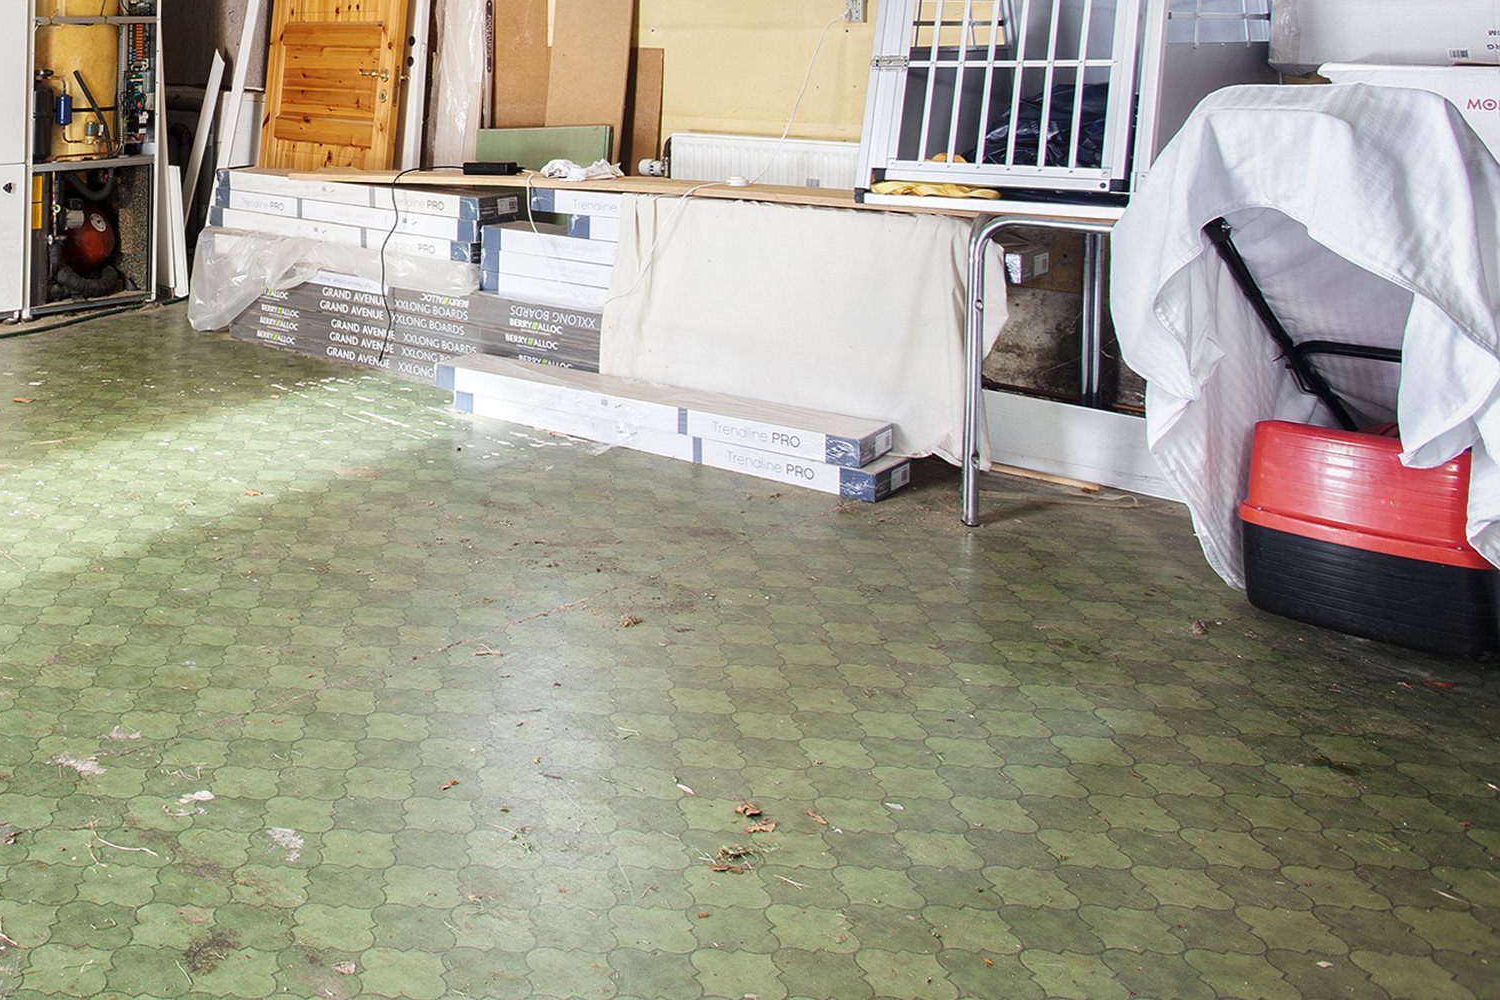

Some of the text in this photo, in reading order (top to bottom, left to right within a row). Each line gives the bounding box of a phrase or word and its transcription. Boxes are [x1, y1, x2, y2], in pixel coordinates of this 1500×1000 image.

[1467, 99, 1500, 110] MO
[269, 201, 285, 212] PRO
[426, 199, 445, 211] PRO
[574, 199, 618, 212] Trendline
[417, 242, 436, 255] PRO
[322, 287, 352, 301] GRAND
[261, 304, 299, 317] BERRY ALLOC
[320, 300, 384, 320] GRAND AVENUE
[395, 300, 469, 321] XXLONG BOARDS
[510, 305, 597, 329] XXLONG BOARDS
[260, 316, 298, 330] BERRY ALLOC
[331, 320, 396, 341] GRAND AVENUE
[391, 314, 465, 336] XXLONG BOARDS
[509, 317, 564, 335] BERRY ALLOC
[257, 330, 295, 344] BERRY ALLOC
[330, 332, 395, 354] GRAND AVENUE
[404, 333, 477, 354] XXLONG BOARDS
[504, 333, 560, 350] BERRY ALLOC
[327, 347, 391, 369] GRAND AVENUE
[402, 347, 438, 362] XXLONG
[398, 362, 434, 378] XXLONG
[712, 421, 802, 449] Trendline PRO
[727, 452, 815, 481] Trendline PRO
